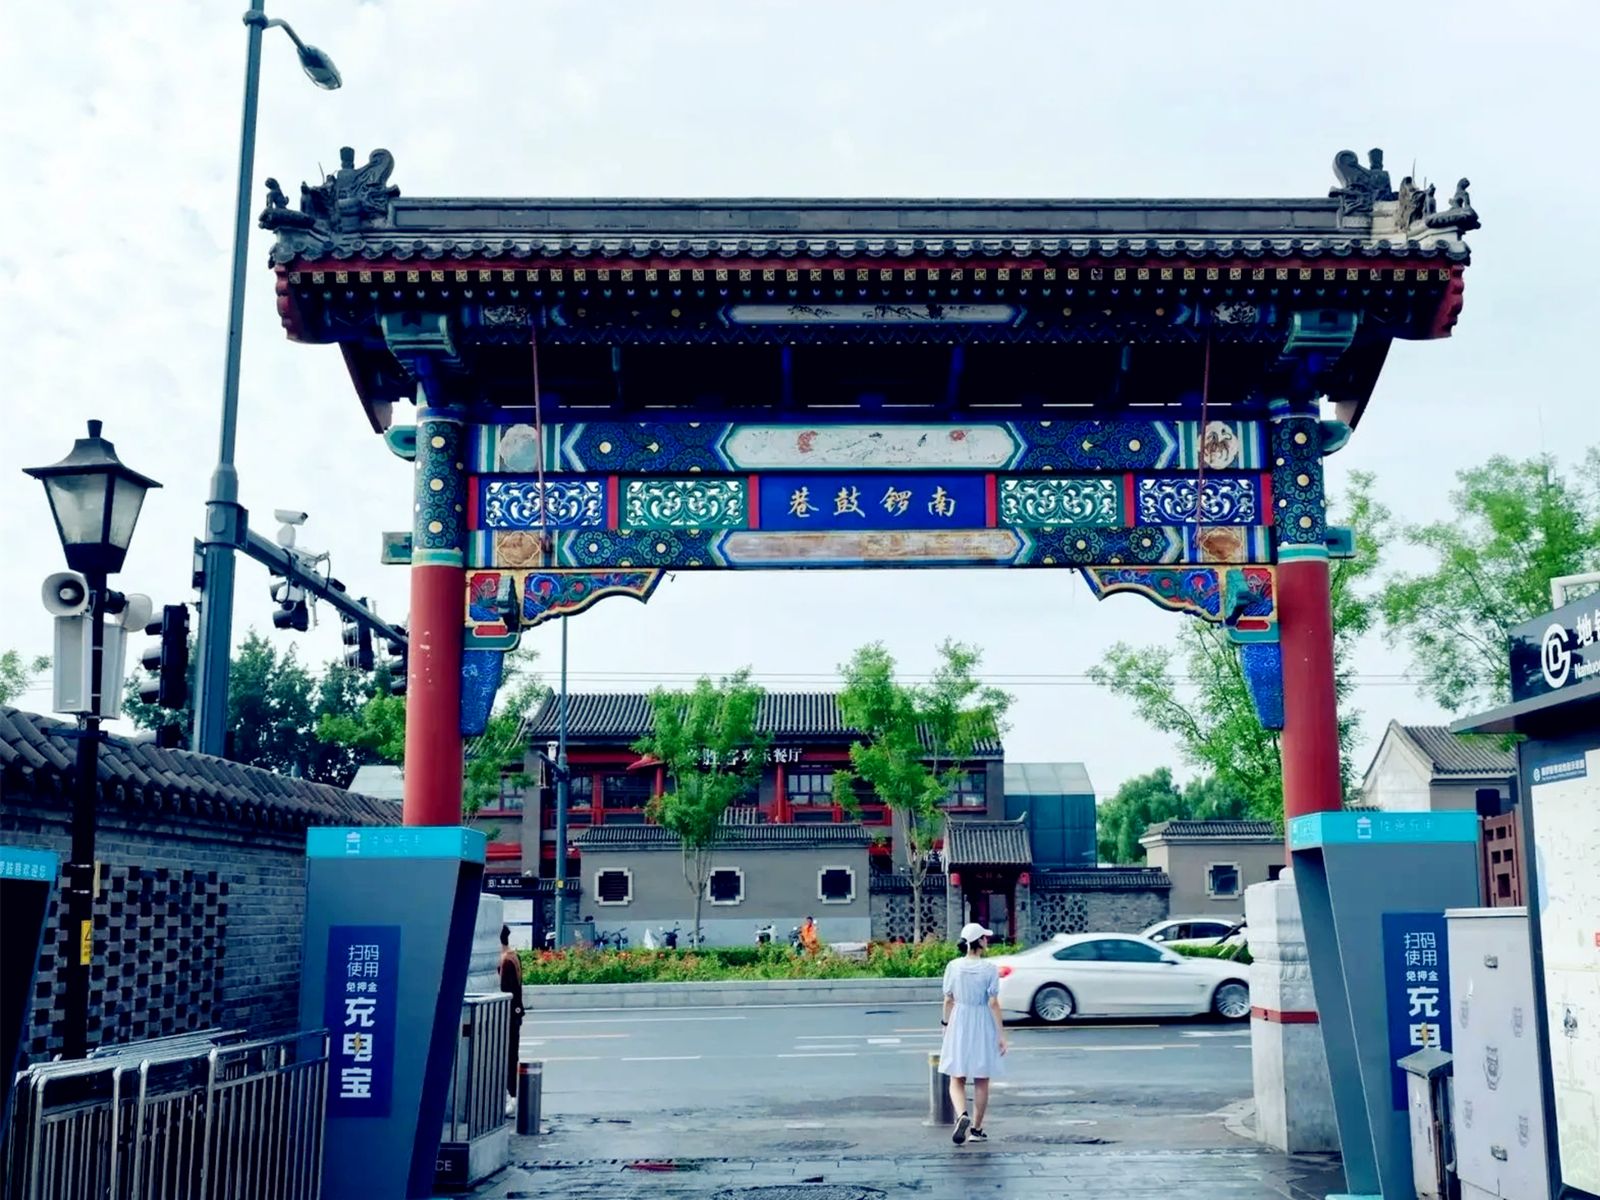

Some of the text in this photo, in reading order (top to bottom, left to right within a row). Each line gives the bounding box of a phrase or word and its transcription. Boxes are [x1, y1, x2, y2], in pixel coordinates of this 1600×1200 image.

[1404, 932, 1436, 949] 扫码
[348, 944, 379, 961] 扫码
[1405, 950, 1438, 966] 使用
[346, 961, 379, 977] 使用
[1406, 970, 1439, 982] 免押金
[346, 981, 378, 993] 免押金
[340, 997, 377, 1098] 充电宝
